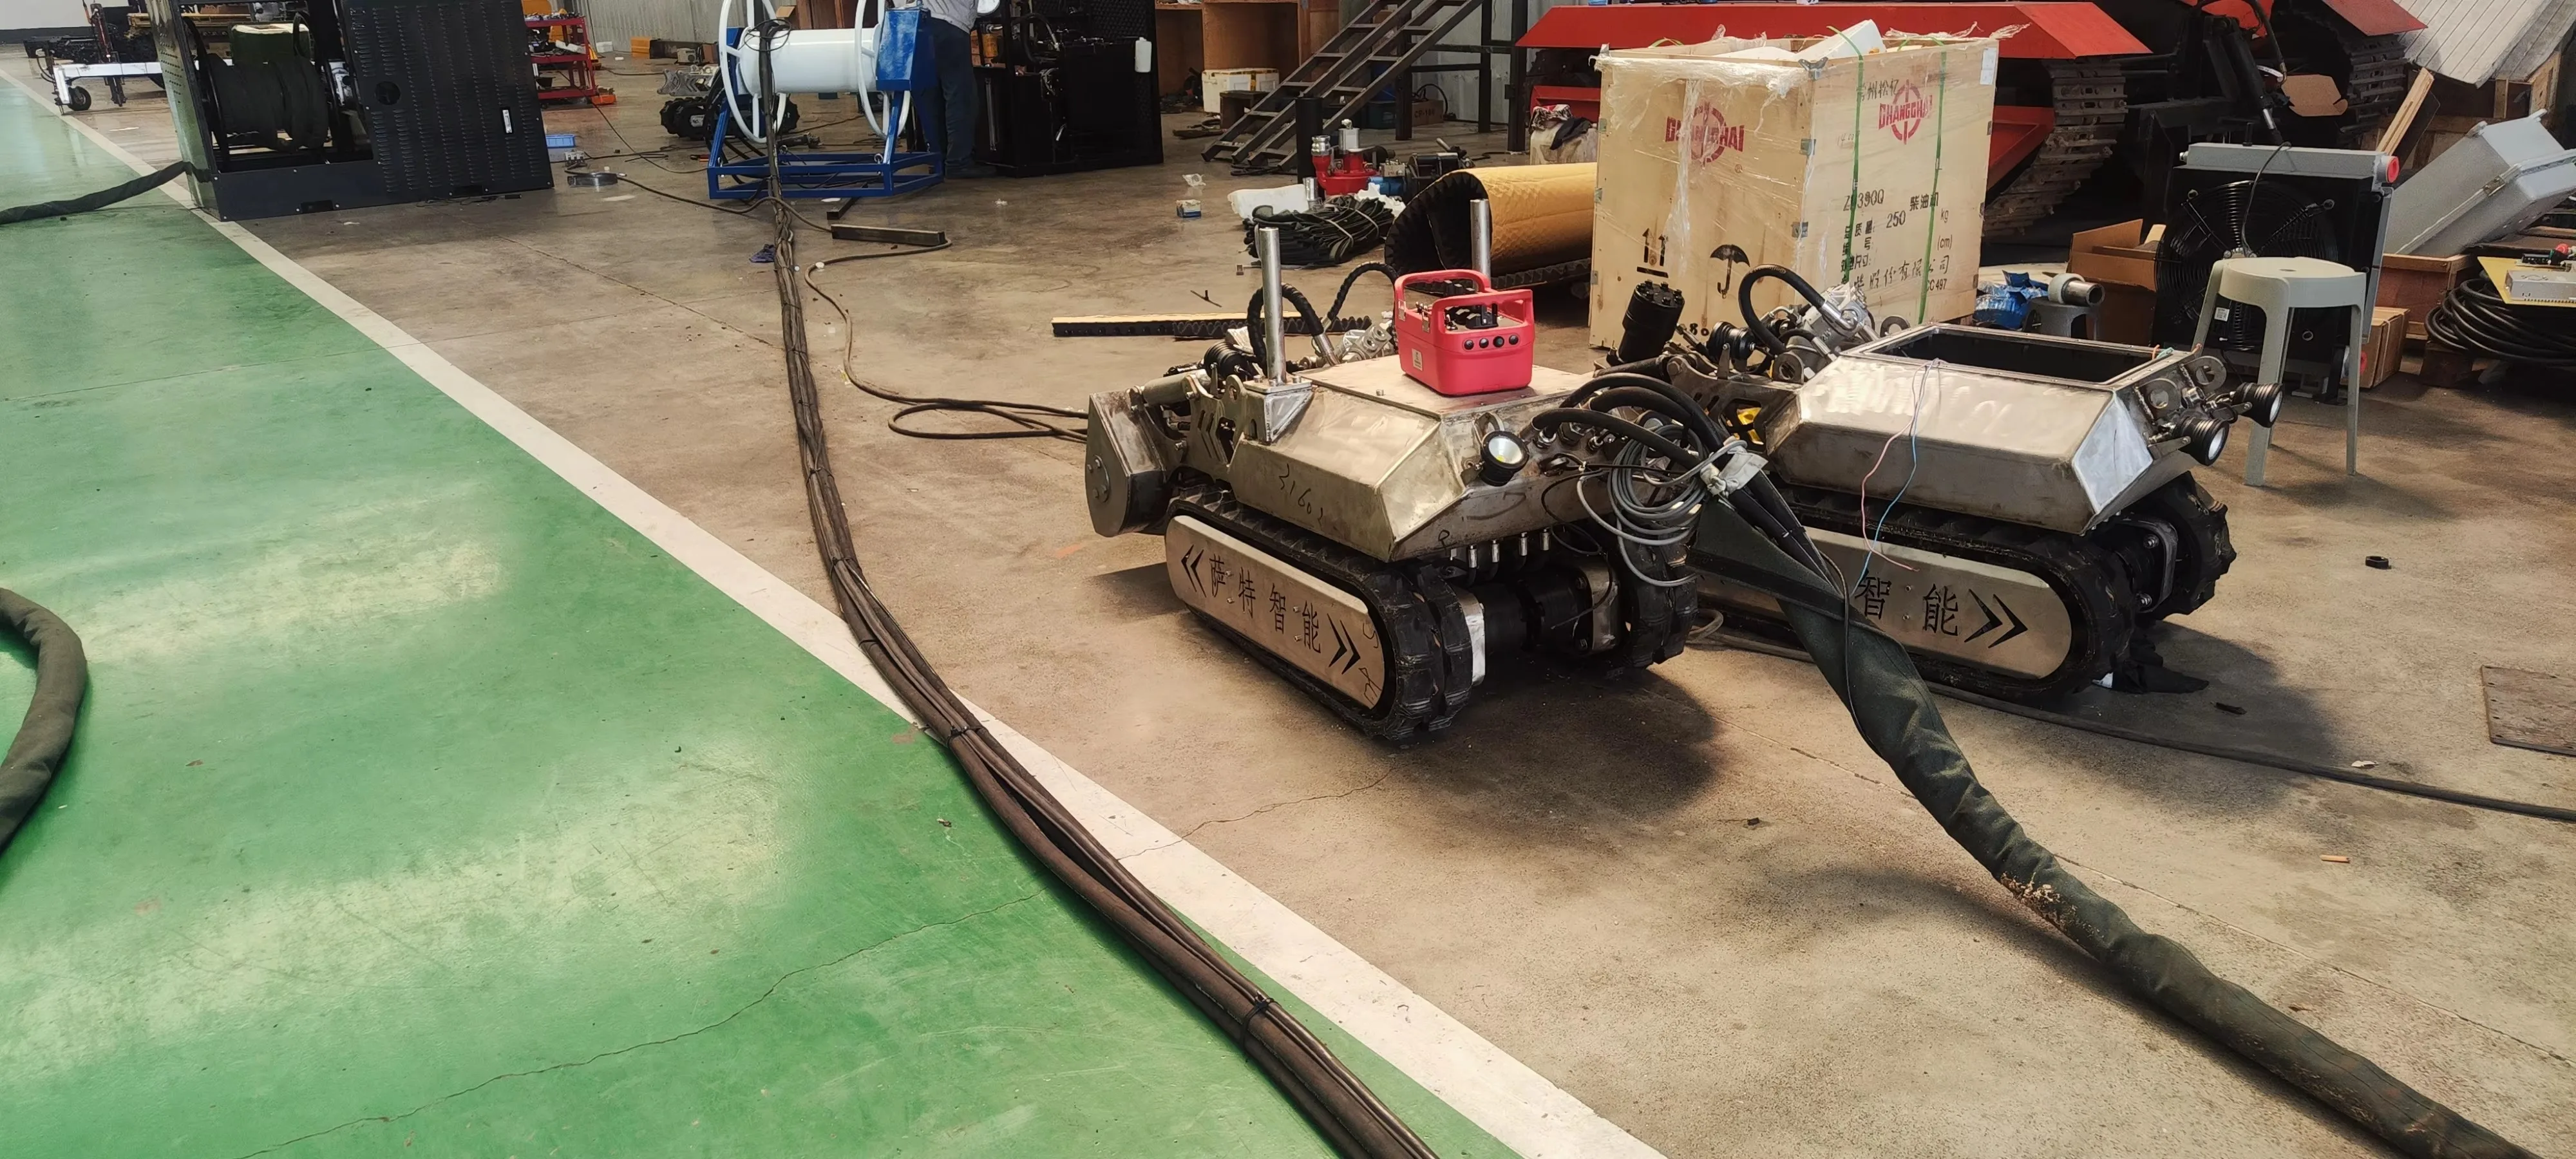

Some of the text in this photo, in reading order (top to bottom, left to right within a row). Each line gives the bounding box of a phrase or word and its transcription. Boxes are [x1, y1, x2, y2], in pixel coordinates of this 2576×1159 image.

[1886, 208, 1949, 229] 250 kg
[1937, 234, 1953, 250] (cm)
[1209, 553, 1321, 654] 萨特智能
[1854, 566, 1959, 637] 智能
